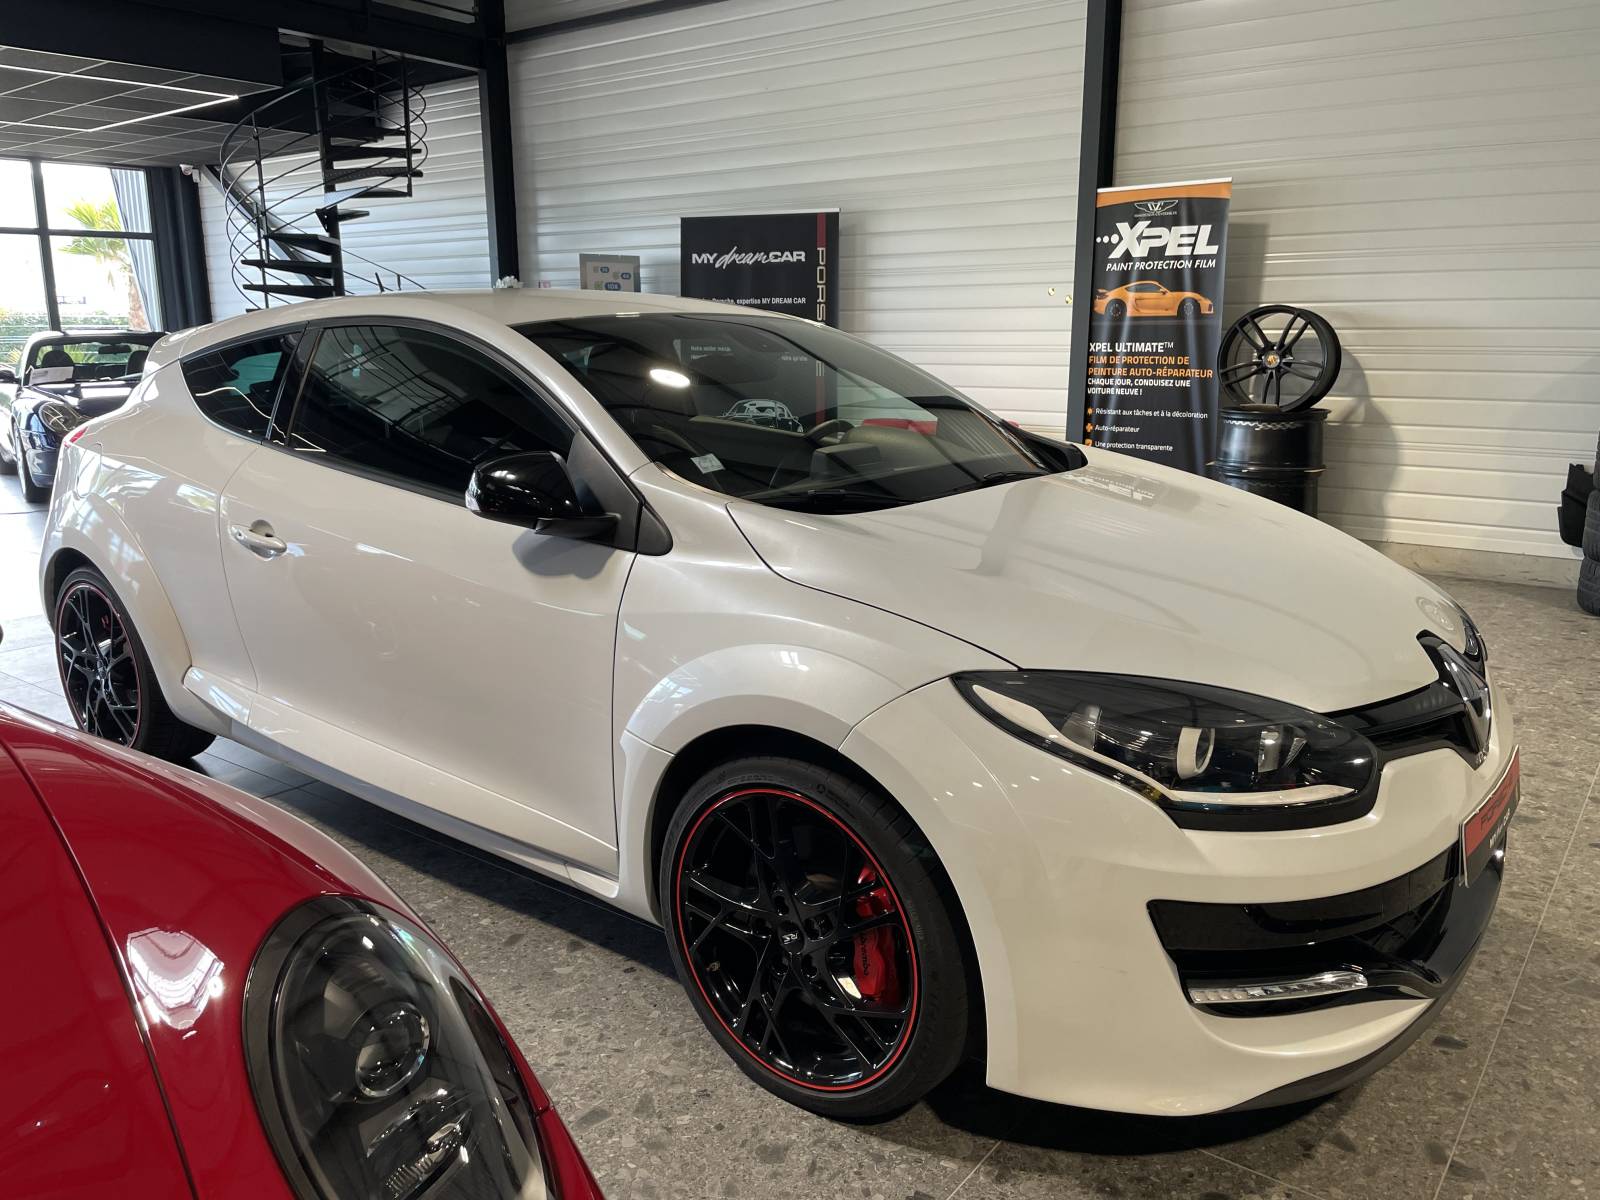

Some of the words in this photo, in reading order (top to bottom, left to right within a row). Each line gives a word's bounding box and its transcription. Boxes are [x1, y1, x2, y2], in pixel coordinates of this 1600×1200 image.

[1108, 220, 1219, 259] XPEL
[691, 253, 718, 264] MY
[714, 246, 771, 269] dream
[769, 251, 806, 263] CAR
[1106, 262, 1133, 272] PAINT
[1134, 261, 1192, 271] PROTECTION
[1194, 259, 1217, 268] FILM
[1089, 342, 1113, 353] XPEL
[1088, 355, 1108, 365] FILM
[1109, 356, 1120, 365] DE
[1121, 356, 1175, 365] PROTECTION
[1177, 356, 1190, 365] DE
[1088, 367, 1128, 376] PEINTURE
[1129, 366, 1213, 378] AUTO-RÉPARATEUR
[1087, 378, 1114, 386] CHAQUE
[1134, 379, 1174, 387] CONDUISEZ
[1115, 388, 1138, 396] NEUVE
[1153, 409, 1160, 417] et
[1165, 409, 1171, 417] la
[1106, 441, 1134, 450] protection
